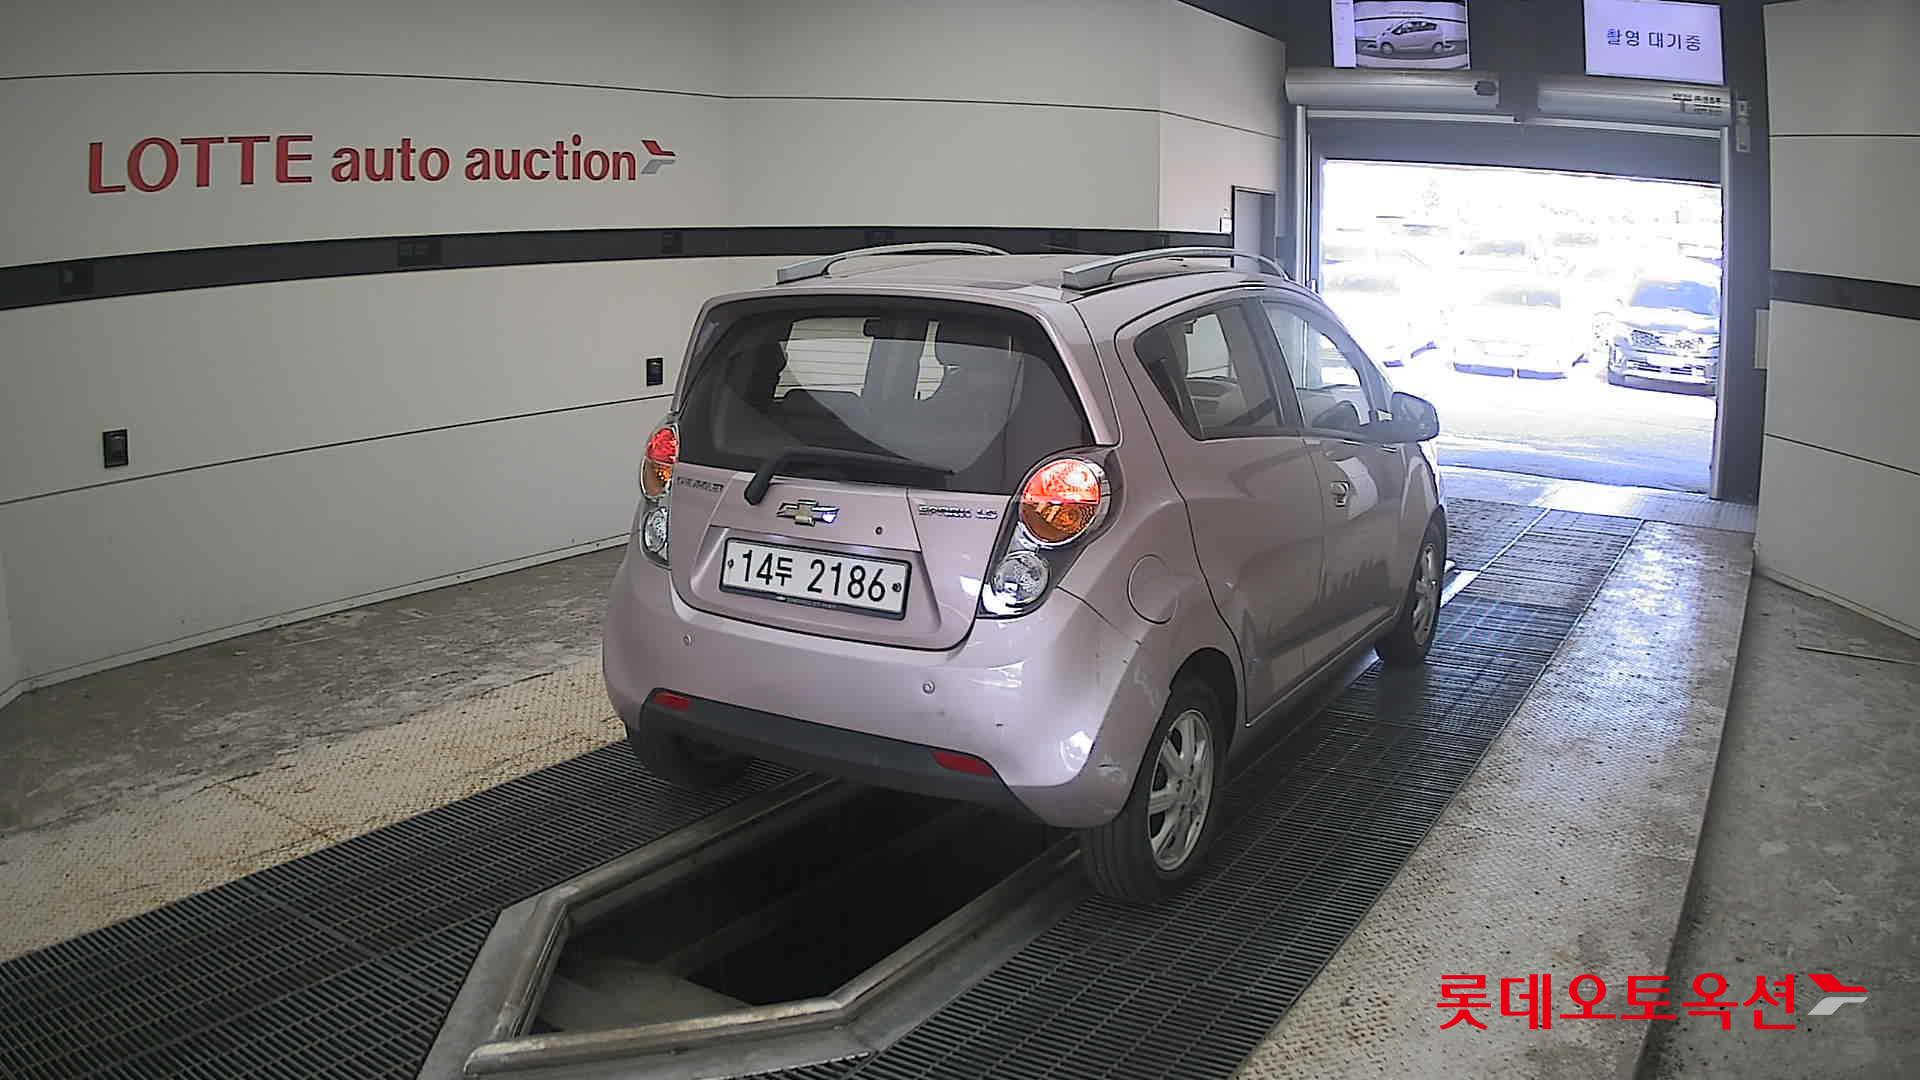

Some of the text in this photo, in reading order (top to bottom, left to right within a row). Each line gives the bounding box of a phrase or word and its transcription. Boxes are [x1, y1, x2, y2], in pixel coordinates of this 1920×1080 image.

[1648, 31, 1701, 52] 대기중
[88, 133, 638, 194] LOTTE auto auction
[742, 549, 886, 602] 14두 2186
